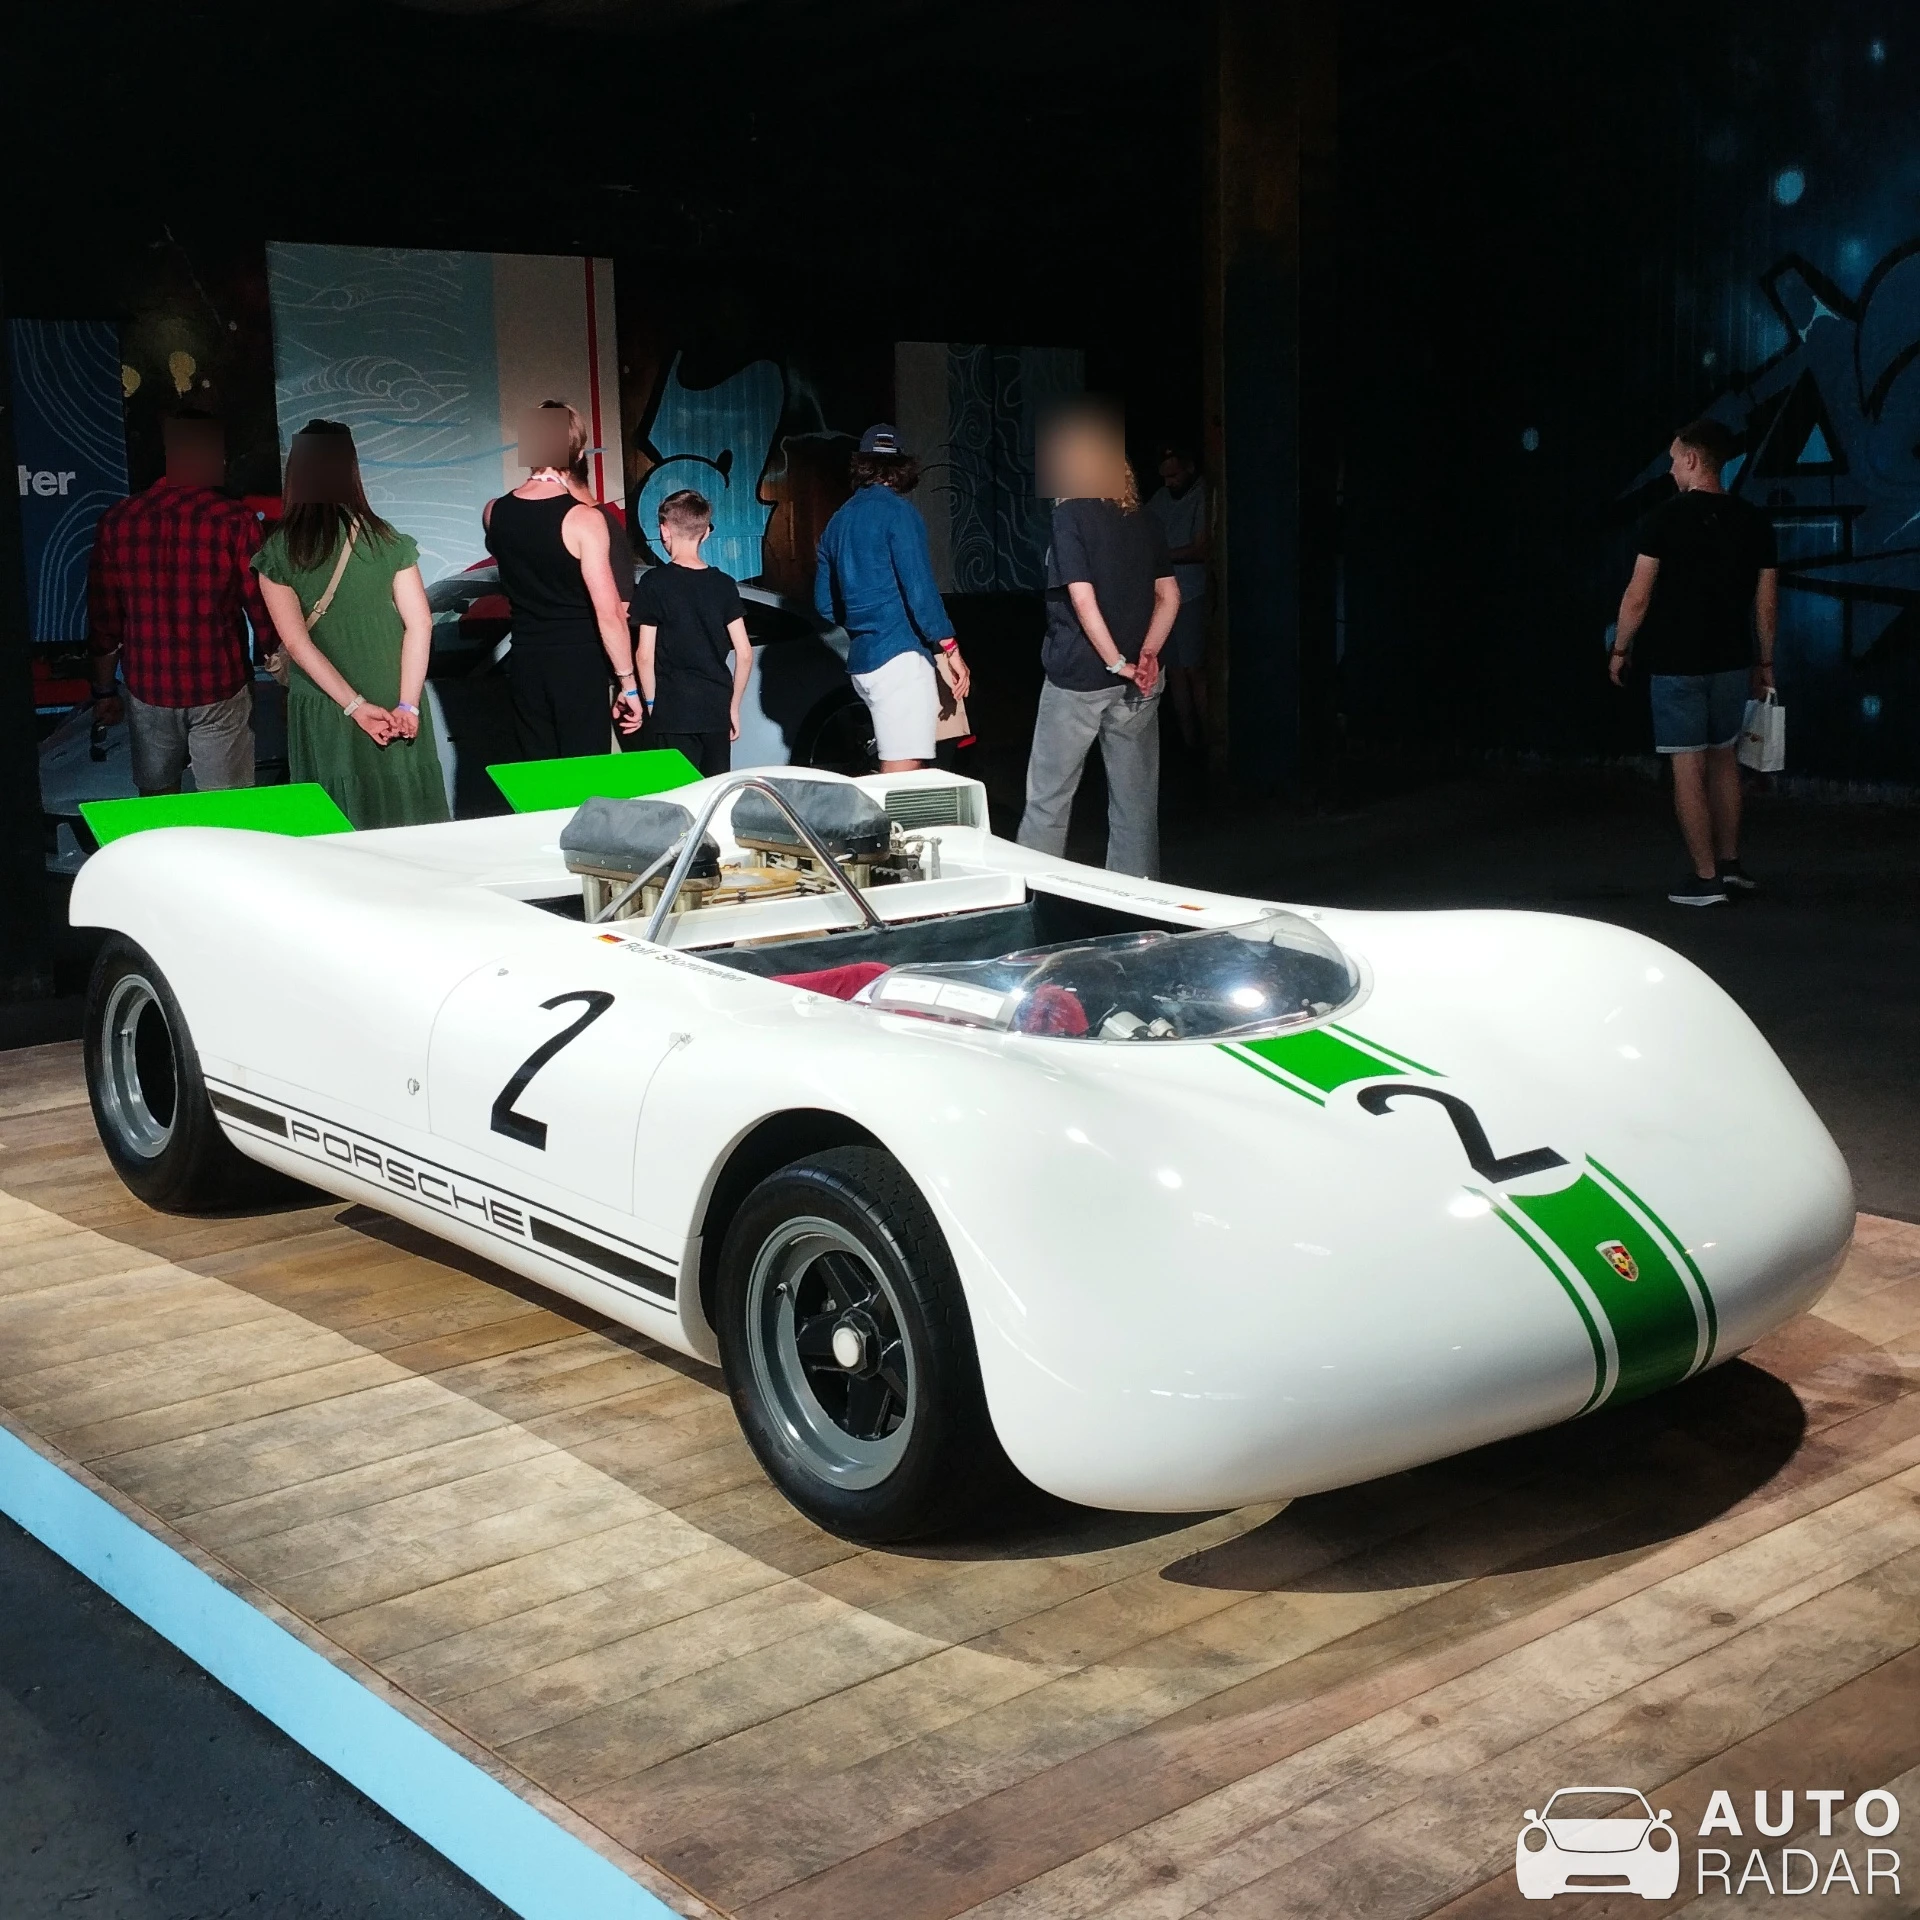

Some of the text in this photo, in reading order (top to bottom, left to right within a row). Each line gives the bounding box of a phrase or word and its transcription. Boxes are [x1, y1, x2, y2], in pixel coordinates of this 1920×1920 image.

[619, 942, 661, 955] Rolf
[490, 990, 615, 1151] 2
[291, 1119, 526, 1237] PORSCHE
[1357, 1083, 1571, 1184] 2
